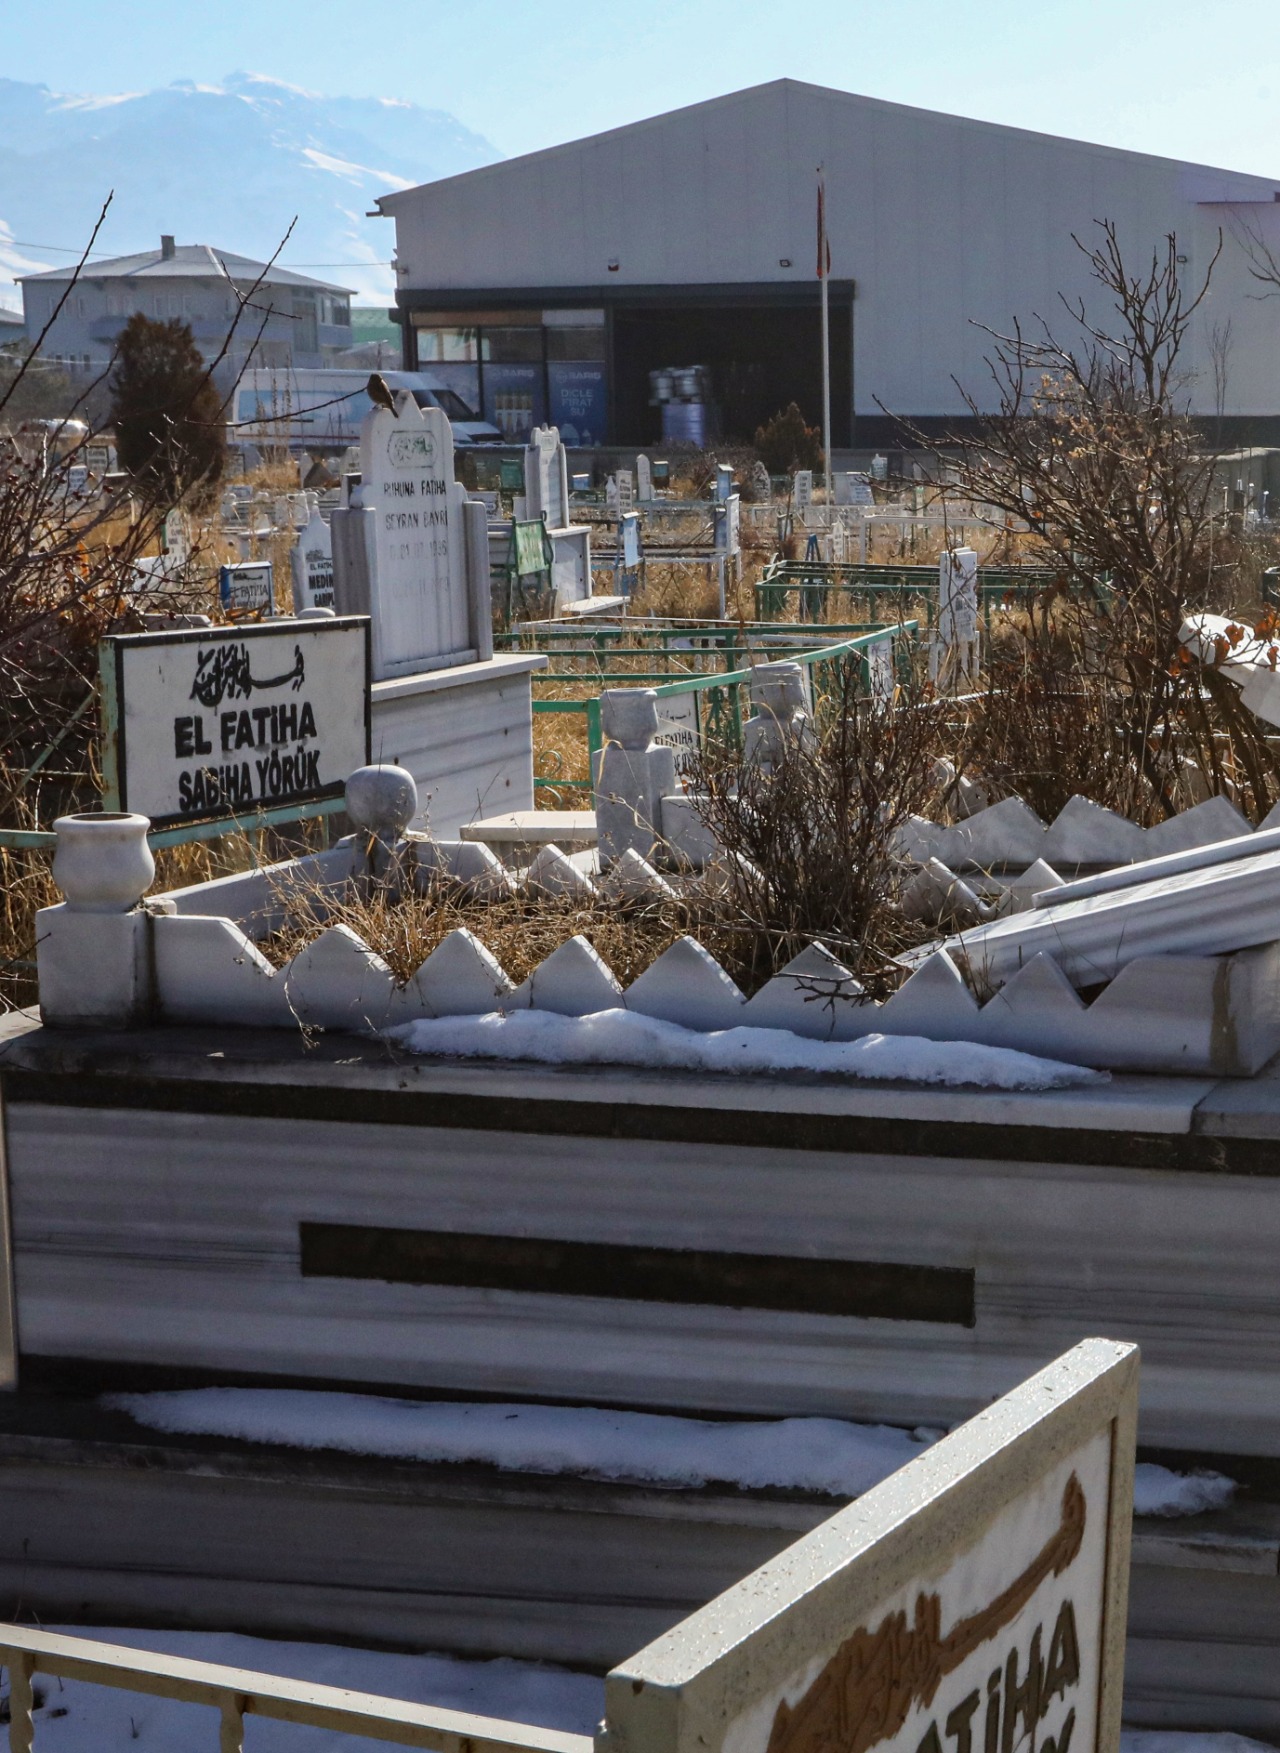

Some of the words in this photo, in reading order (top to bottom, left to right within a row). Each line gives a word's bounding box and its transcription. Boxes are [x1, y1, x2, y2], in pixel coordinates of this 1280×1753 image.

[561, 398, 593, 407] FIRAT
[570, 408, 586, 416] SU
[174, 716, 212, 759] EL
[255, 745, 322, 798] YÖRÜK
